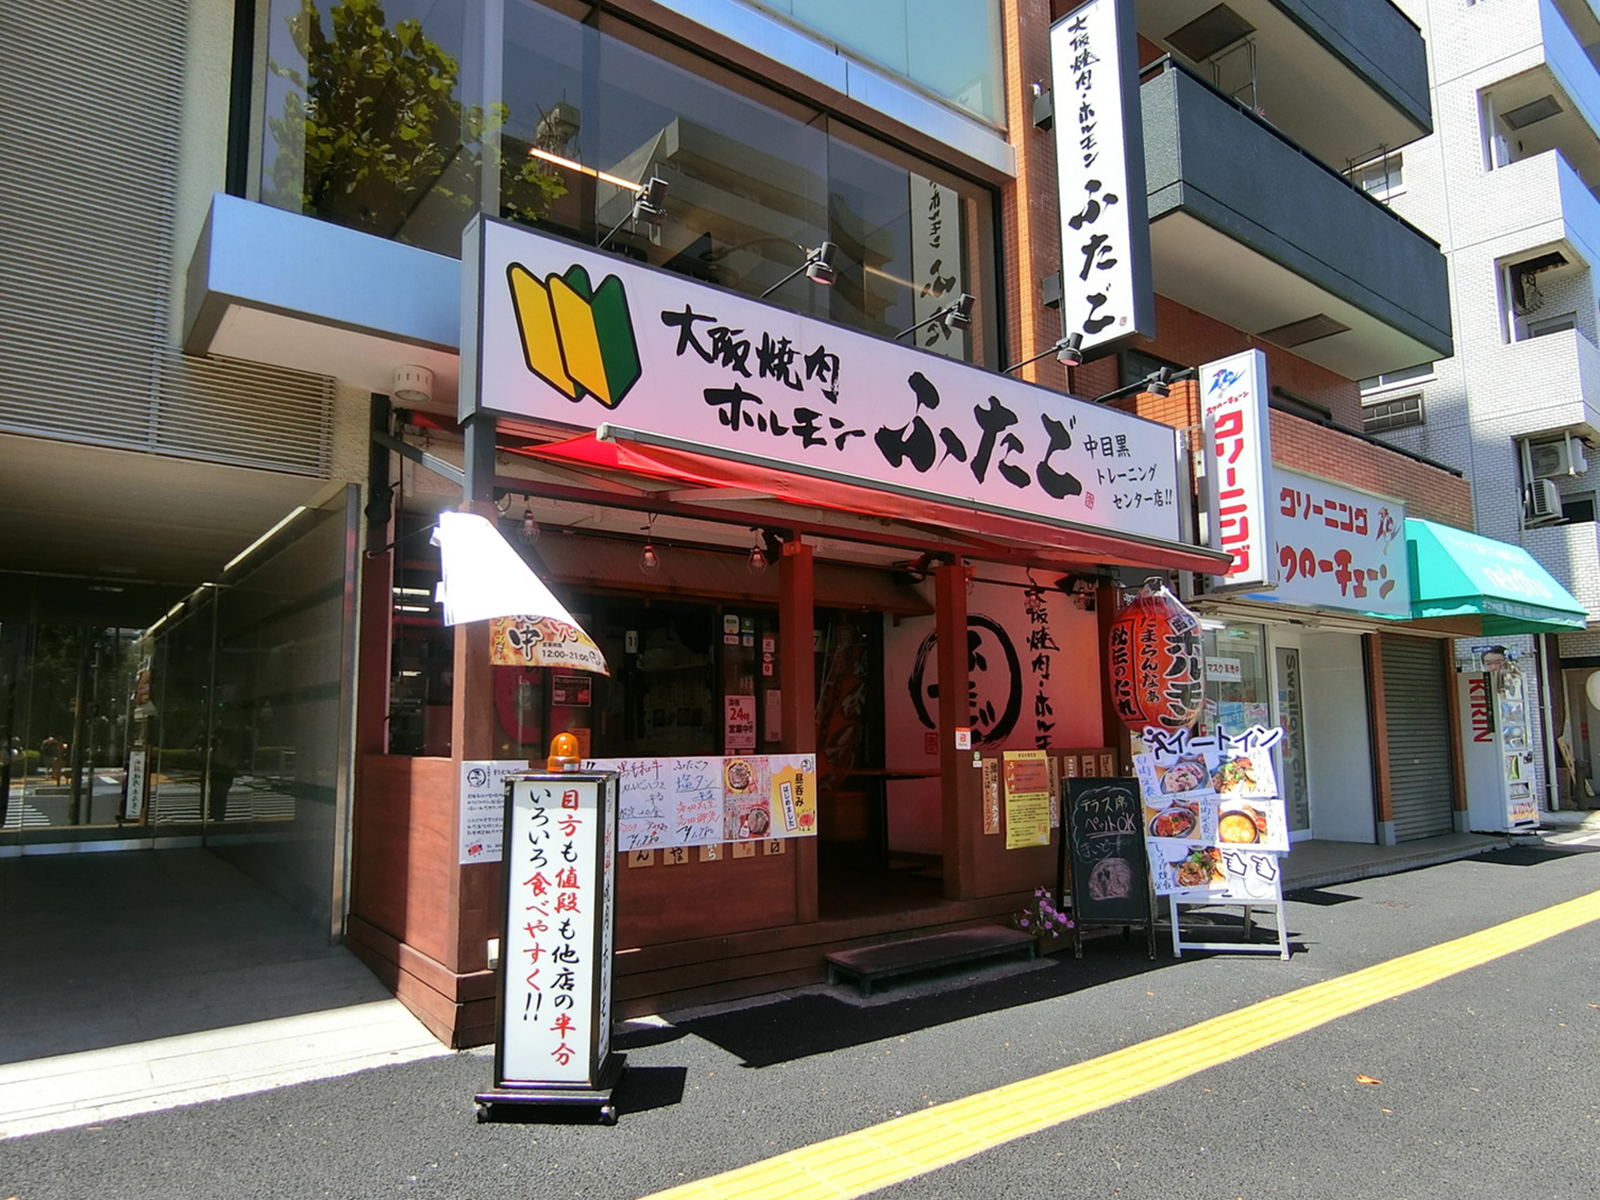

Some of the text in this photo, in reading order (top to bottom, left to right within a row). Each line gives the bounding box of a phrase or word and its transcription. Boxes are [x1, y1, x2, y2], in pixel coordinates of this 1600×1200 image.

[1068, 179, 1119, 334] ふたご
[661, 304, 840, 404] 大阪焼肉
[703, 382, 866, 451] ホルモン
[874, 371, 1083, 500] ふたご
[1083, 434, 1131, 459] 中目黒
[1096, 463, 1157, 485] トレーニング
[1214, 410, 1251, 574] クリーニング
[1280, 487, 1368, 535] クリーニング
[1276, 541, 1395, 599] ワローチェーン
[1111, 624, 1137, 716] 秘伝のたれ
[1207, 663, 1223, 674] マスク
[1286, 654, 1299, 751] Swallow
[1468, 678, 1493, 742] KIRIN
[1085, 813, 1137, 832] ペットOK
[522, 788, 552, 1022] いろいろ食べやすく!!
[549, 789, 583, 1066] 目方も値段も他店の半分
